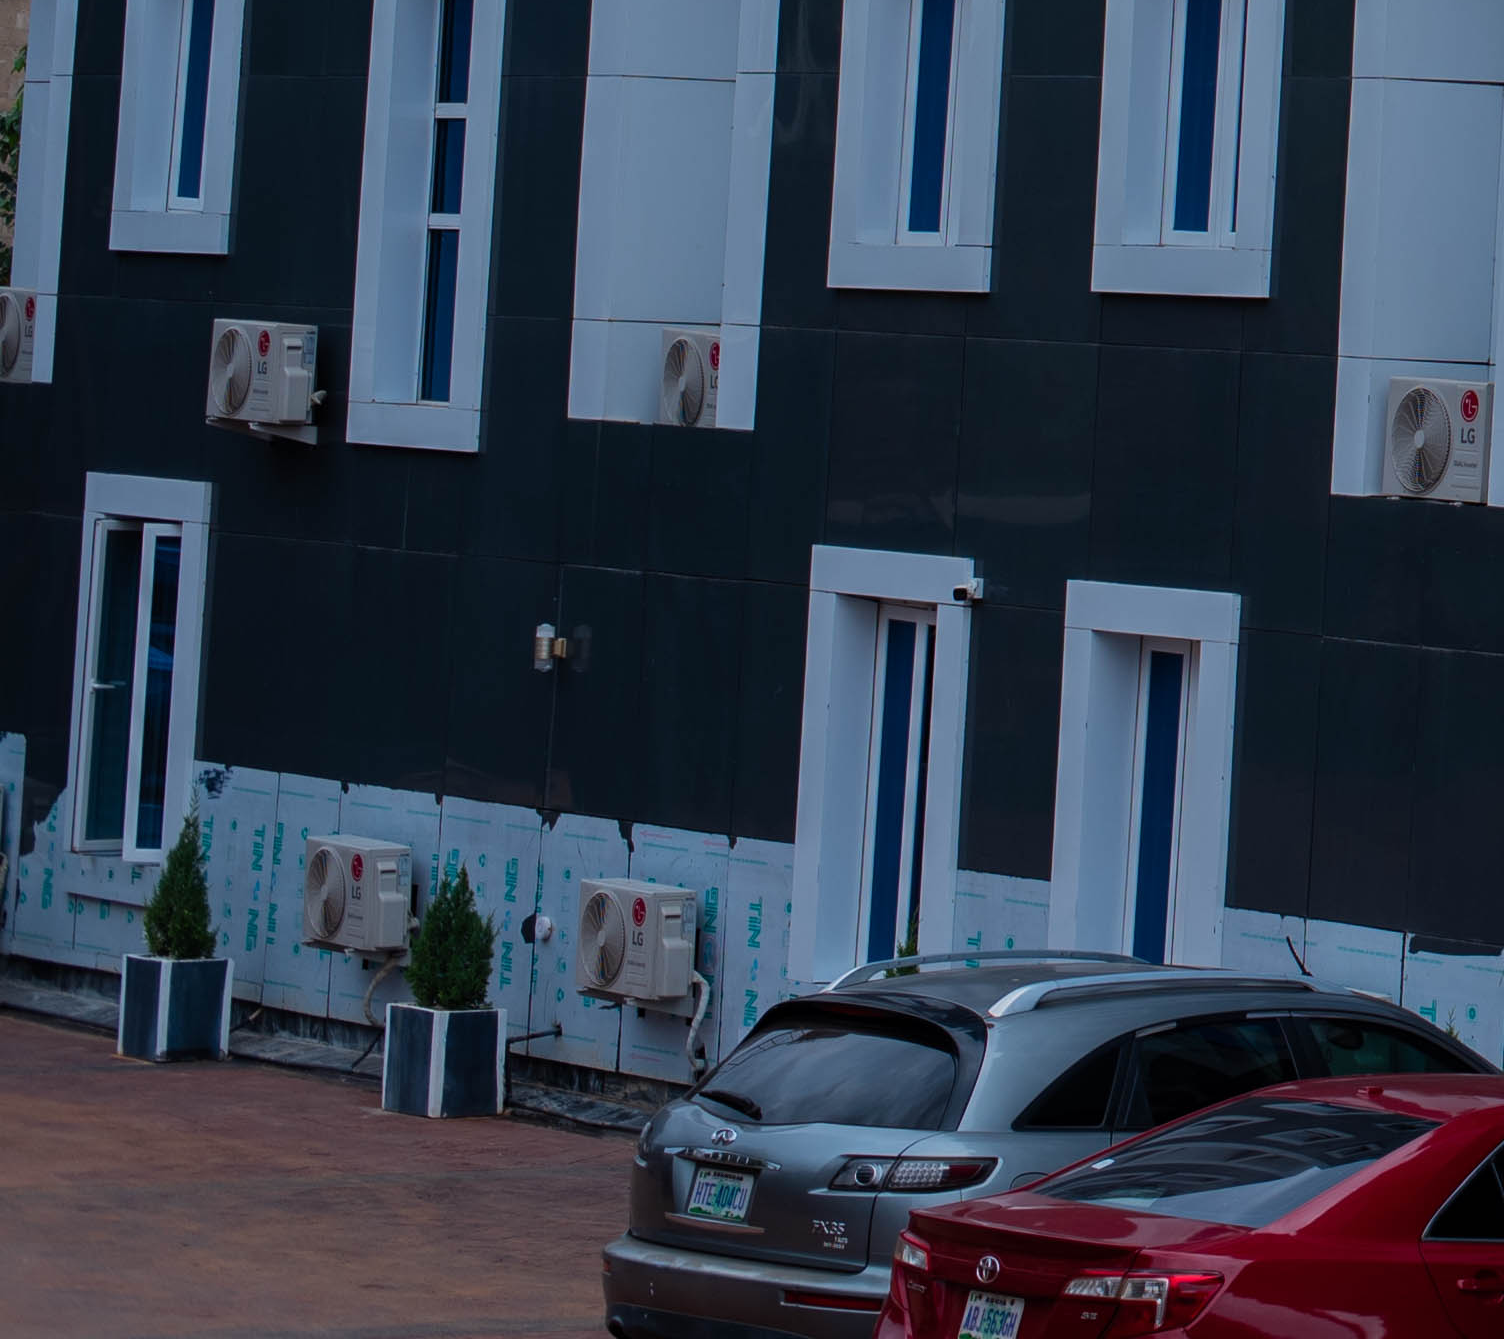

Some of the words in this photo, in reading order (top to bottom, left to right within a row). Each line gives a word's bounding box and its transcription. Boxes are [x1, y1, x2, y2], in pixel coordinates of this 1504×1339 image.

[257, 361, 267, 375] LG
[1460, 426, 1475, 444] LG
[352, 885, 362, 900] LG
[632, 930, 643, 947] LG
